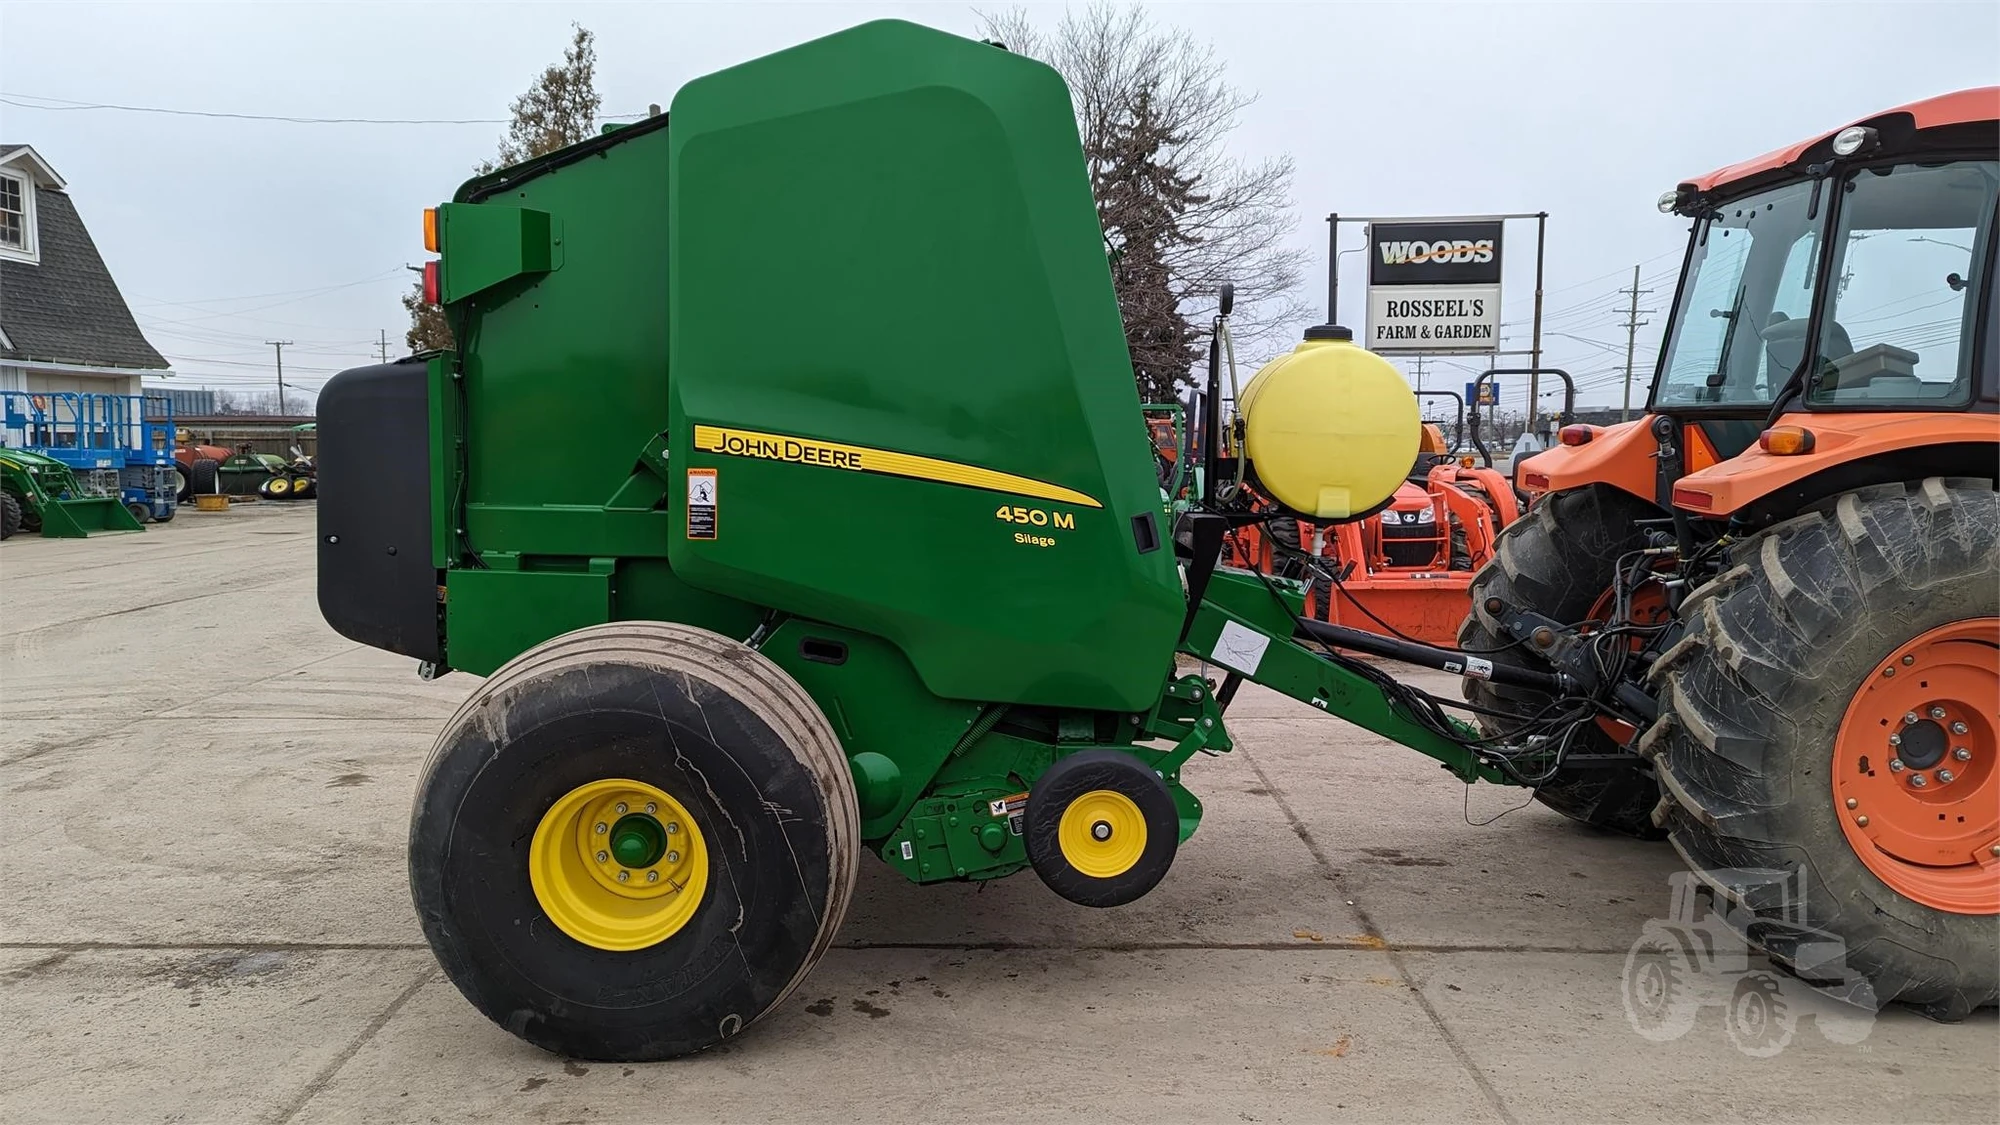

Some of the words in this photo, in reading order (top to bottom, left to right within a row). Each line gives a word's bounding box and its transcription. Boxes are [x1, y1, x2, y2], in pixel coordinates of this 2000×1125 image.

[1379, 239, 1494, 264] WOODS
[1386, 299, 1484, 318] ROSSEEL'S
[1377, 325, 1417, 339] FARM
[1420, 324, 1431, 339] &
[1434, 324, 1492, 339] GARDEN
[713, 432, 778, 457] JOHN
[785, 440, 862, 469] DEERE
[996, 506, 1048, 526] 450
[1053, 512, 1075, 529] M
[1014, 533, 1055, 547] Silage
